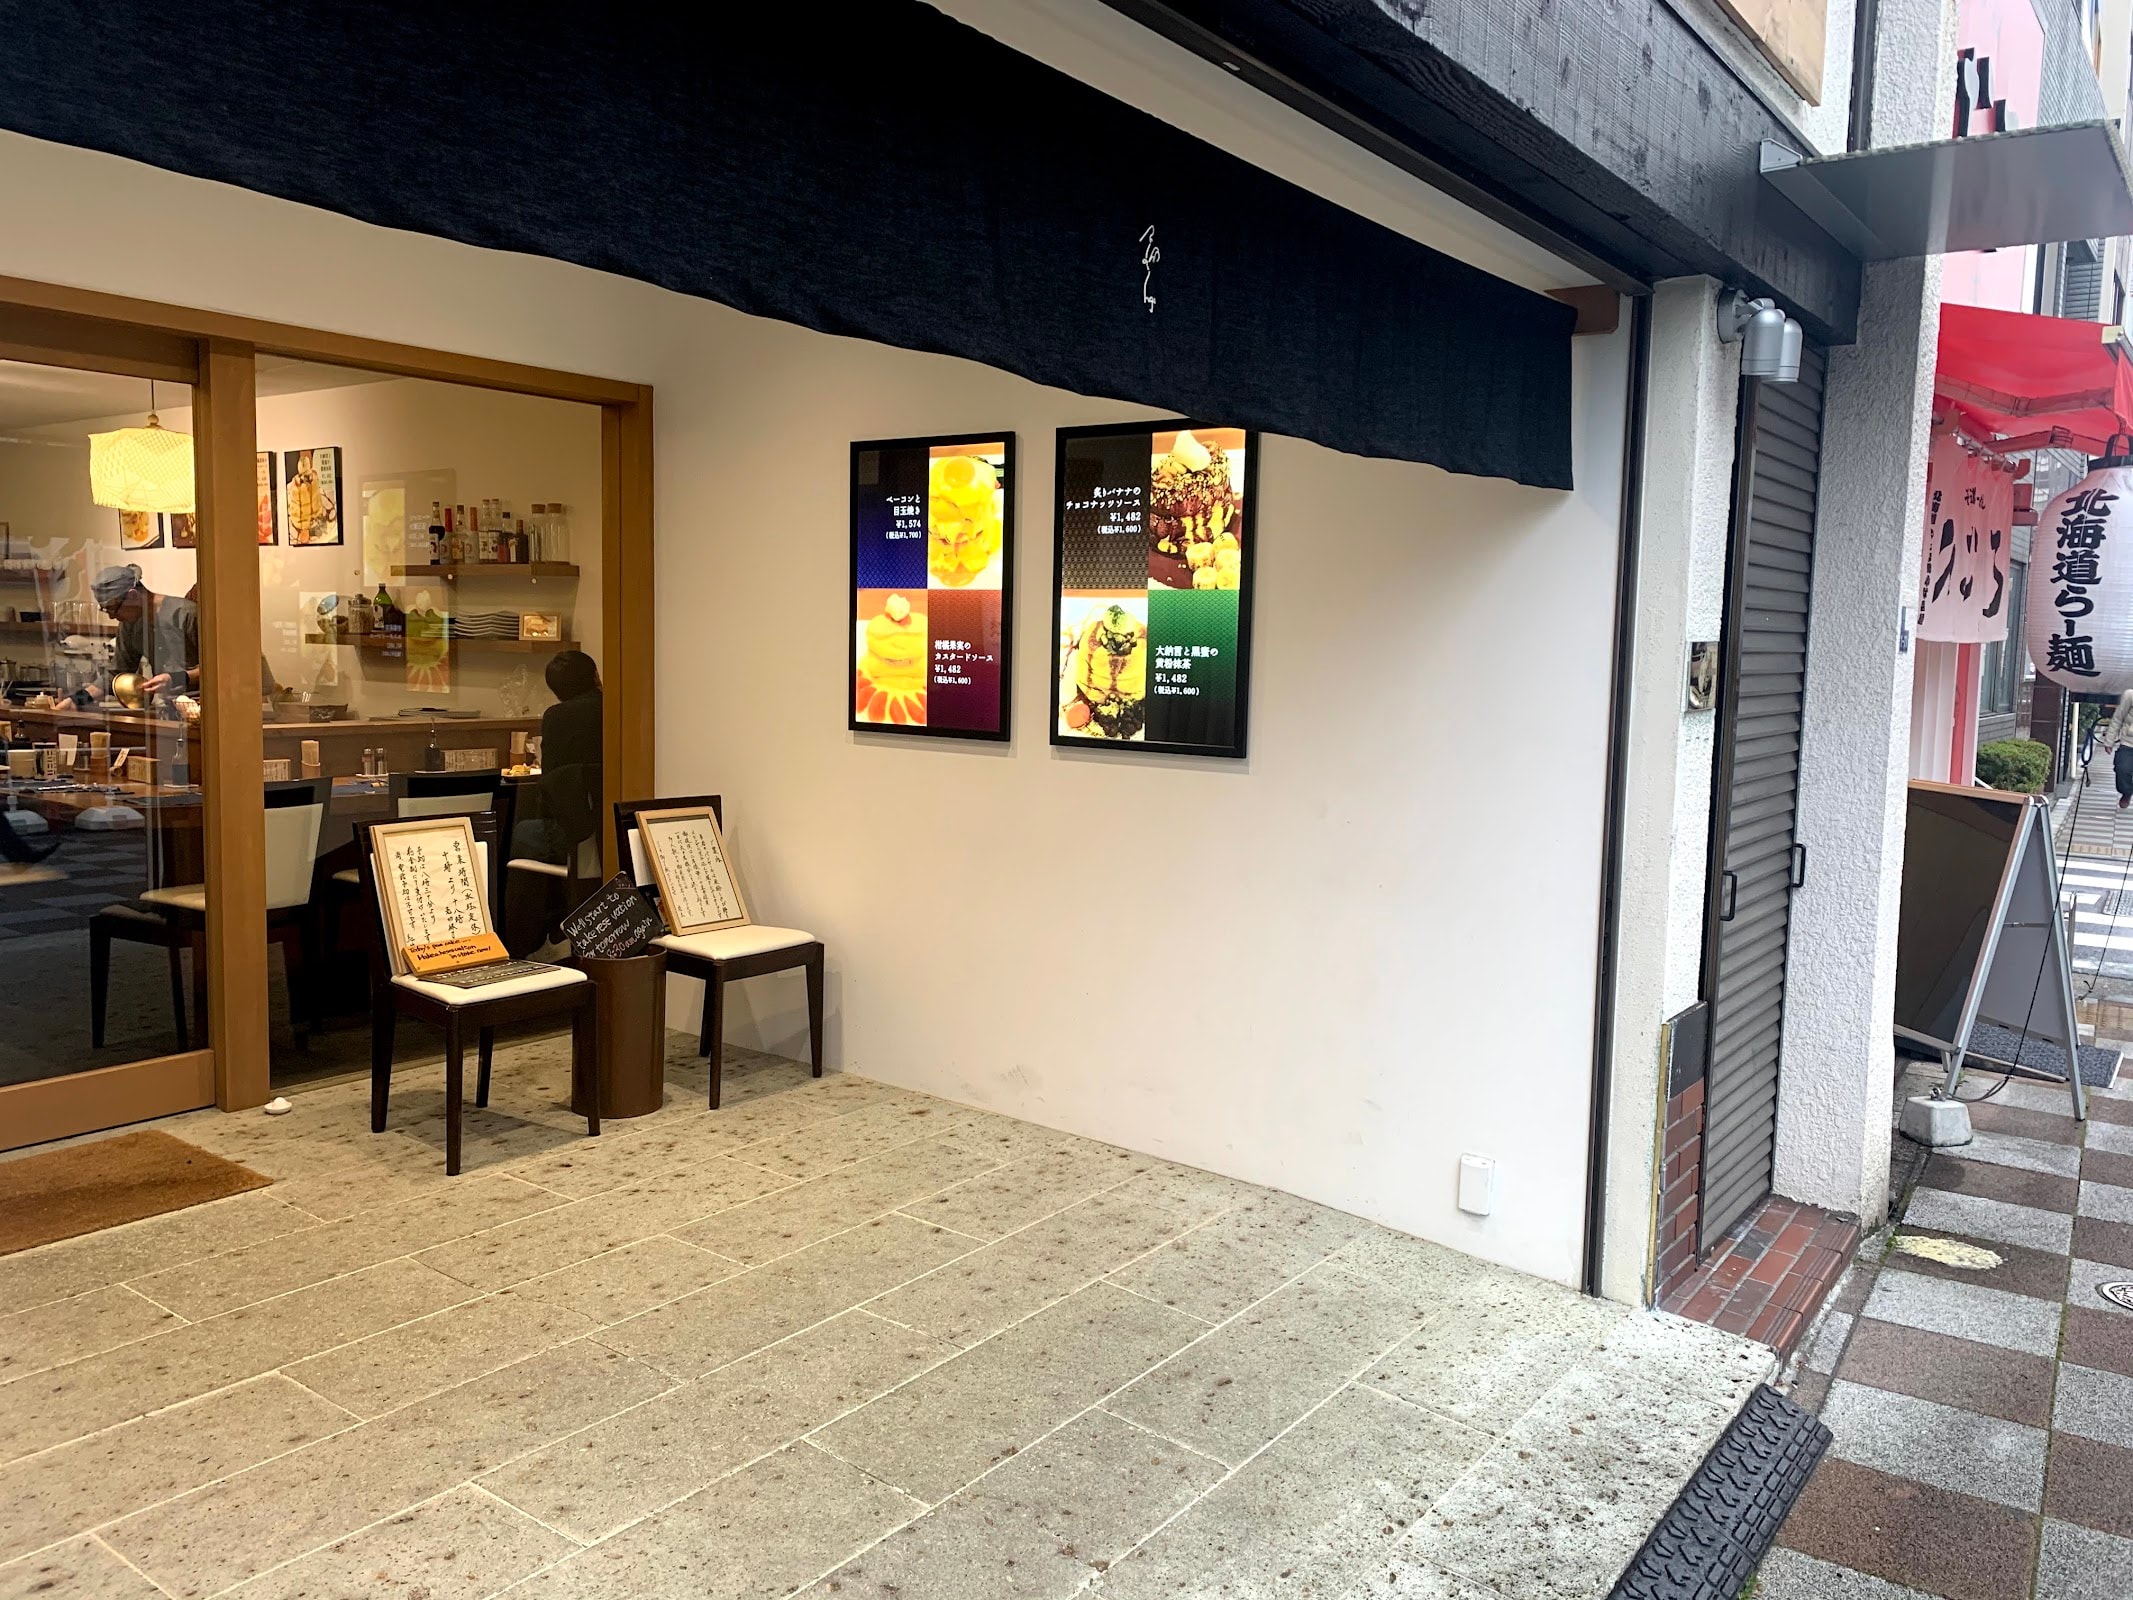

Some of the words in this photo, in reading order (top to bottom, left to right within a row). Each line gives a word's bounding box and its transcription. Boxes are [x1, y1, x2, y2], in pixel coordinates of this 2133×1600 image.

[886, 494, 920, 503] ベーコンと
[1066, 499, 1140, 510] チョコナッツソース
[894, 505, 920, 516] 目玉焼き
[1109, 511, 1141, 523] ¥1,482
[896, 519, 921, 529] ¥1,574
[2046, 488, 2120, 677] 北海道らー麺
[935, 652, 993, 662] カスタードソース
[934, 664, 961, 674] ¥1,482
[1155, 672, 1188, 684] ¥1,482
[606, 893, 620, 902] to
[634, 917, 653, 939] again
[576, 930, 598, 950] take
